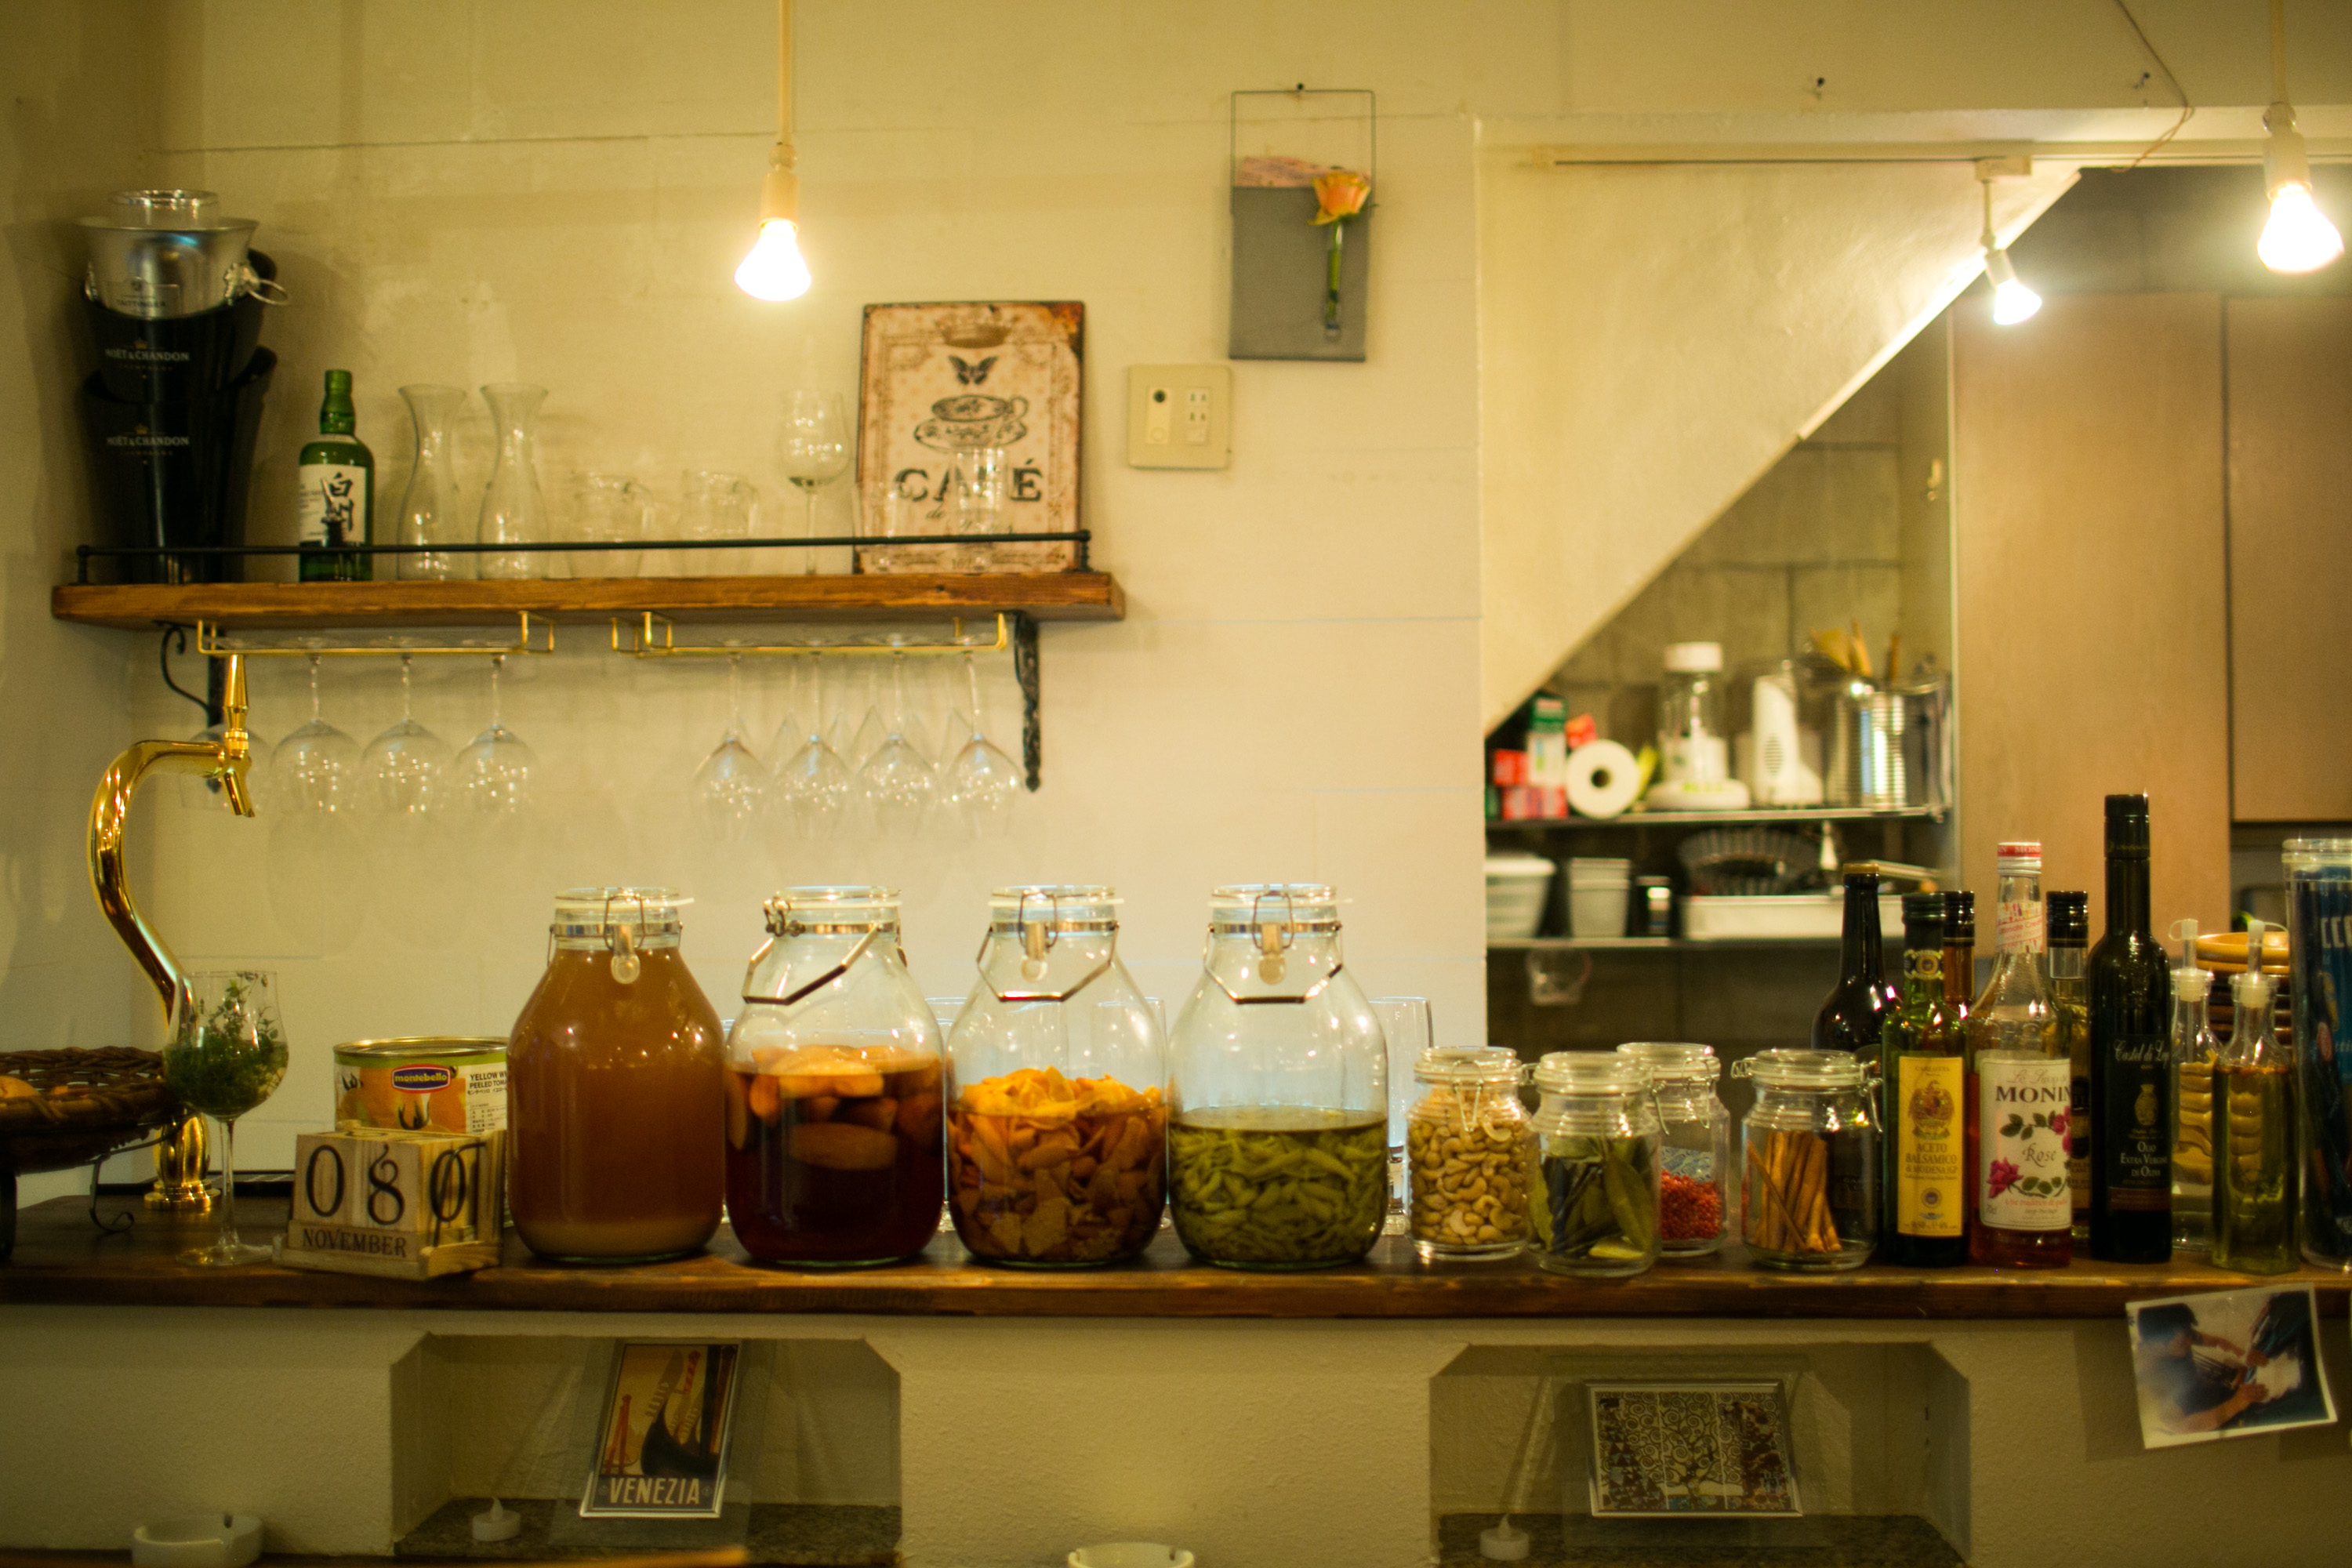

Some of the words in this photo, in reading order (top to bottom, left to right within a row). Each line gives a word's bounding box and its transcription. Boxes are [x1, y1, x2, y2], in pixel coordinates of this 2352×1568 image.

[135, 350, 190, 361] CHANDON
[135, 435, 190, 446] CHANDON
[394, 1072, 448, 1083] montebello
[470, 1072, 498, 1081] YELLOW
[470, 1080, 492, 1089] PEELED
[1917, 1143, 1947, 1152] ACETO
[1906, 1153, 1957, 1164] BALSAMICO
[303, 1228, 407, 1258] NOVEMBER
[609, 1477, 700, 1505] VENEZIA
